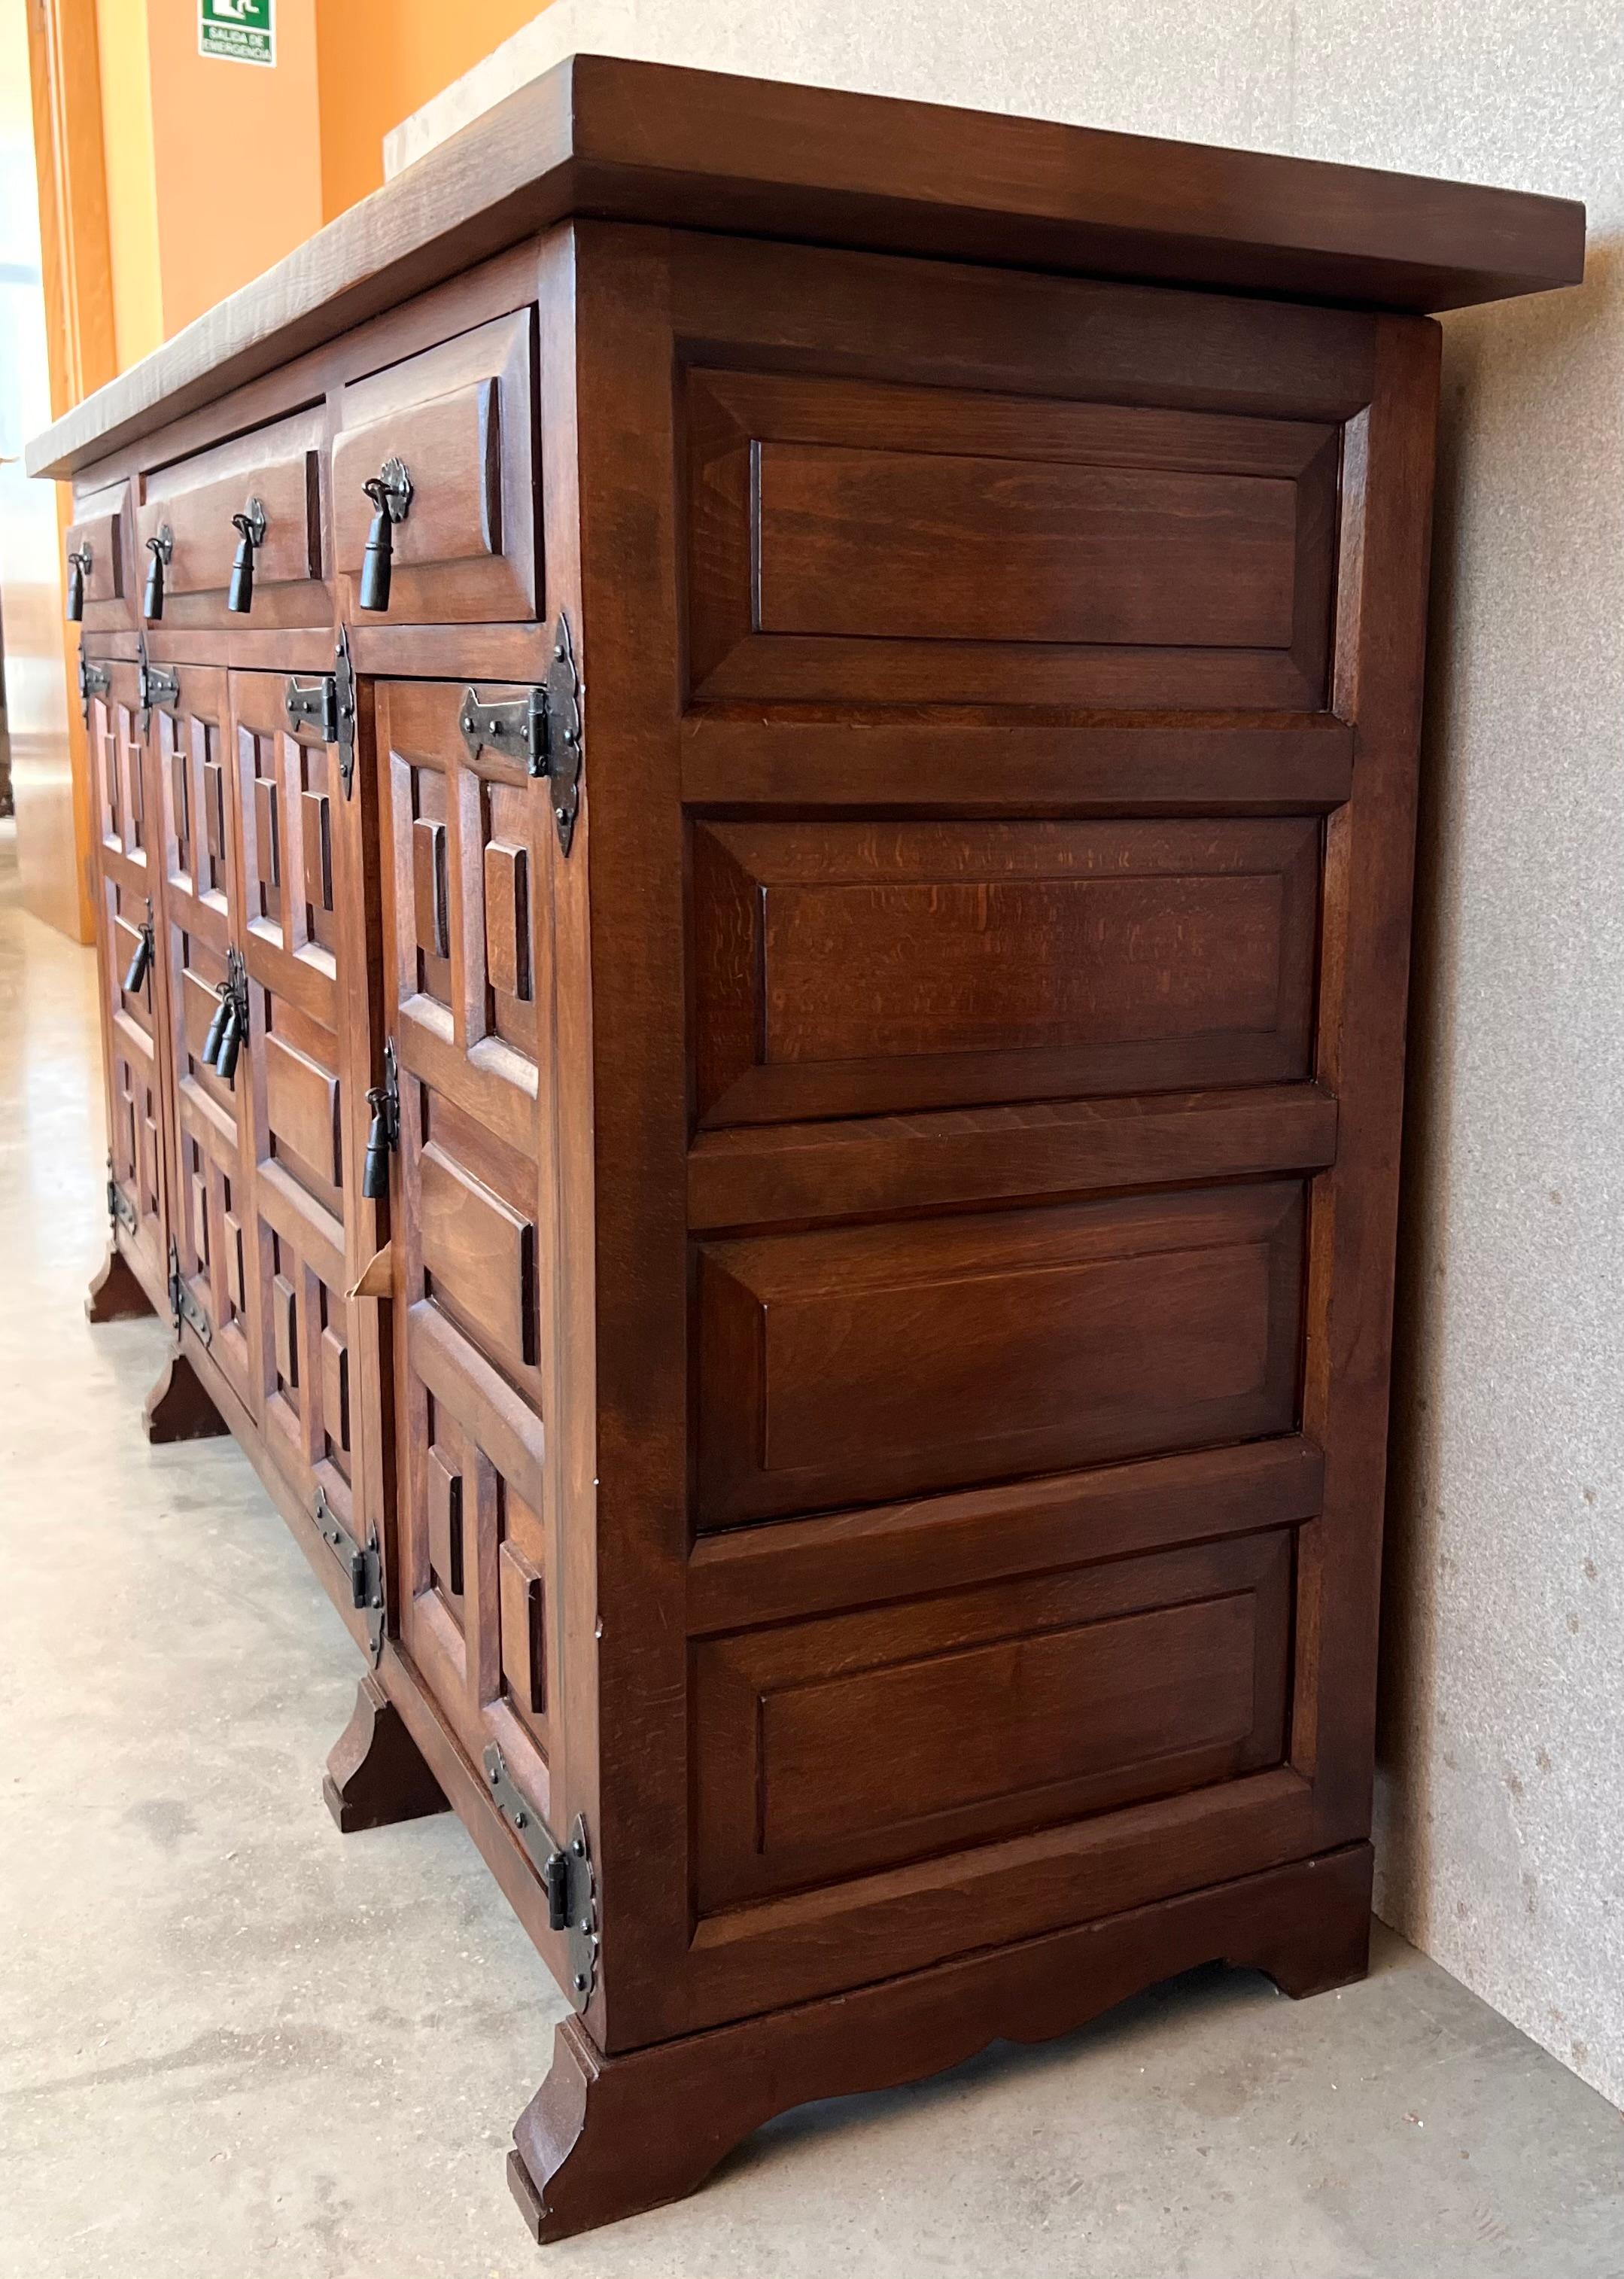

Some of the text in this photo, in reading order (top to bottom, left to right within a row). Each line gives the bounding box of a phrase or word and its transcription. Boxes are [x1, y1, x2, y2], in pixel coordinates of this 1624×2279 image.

[209, 26, 263, 47] SALIDA DE
[203, 38, 272, 60] EMERGENCIA
